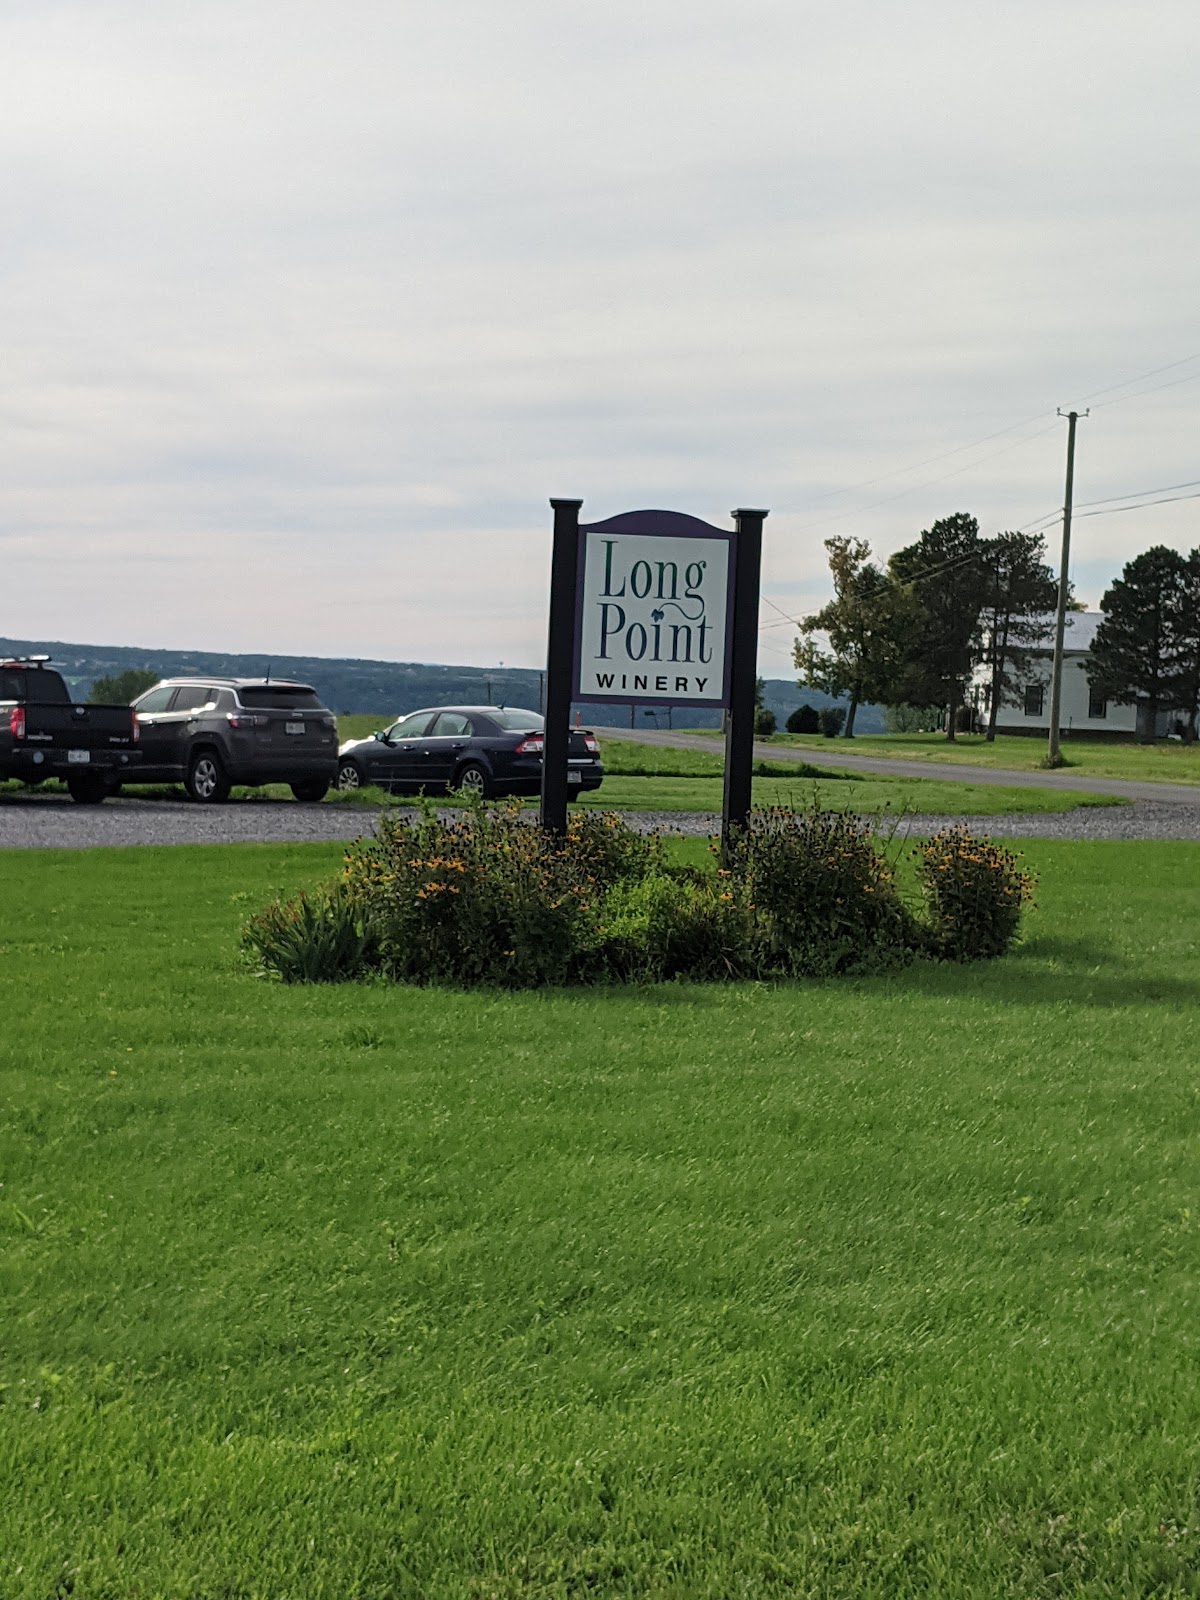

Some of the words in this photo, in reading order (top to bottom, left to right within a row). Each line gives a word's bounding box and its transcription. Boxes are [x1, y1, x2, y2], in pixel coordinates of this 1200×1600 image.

[598, 540, 707, 620] Long
[594, 602, 713, 664] Point
[596, 673, 708, 692] WINERY
